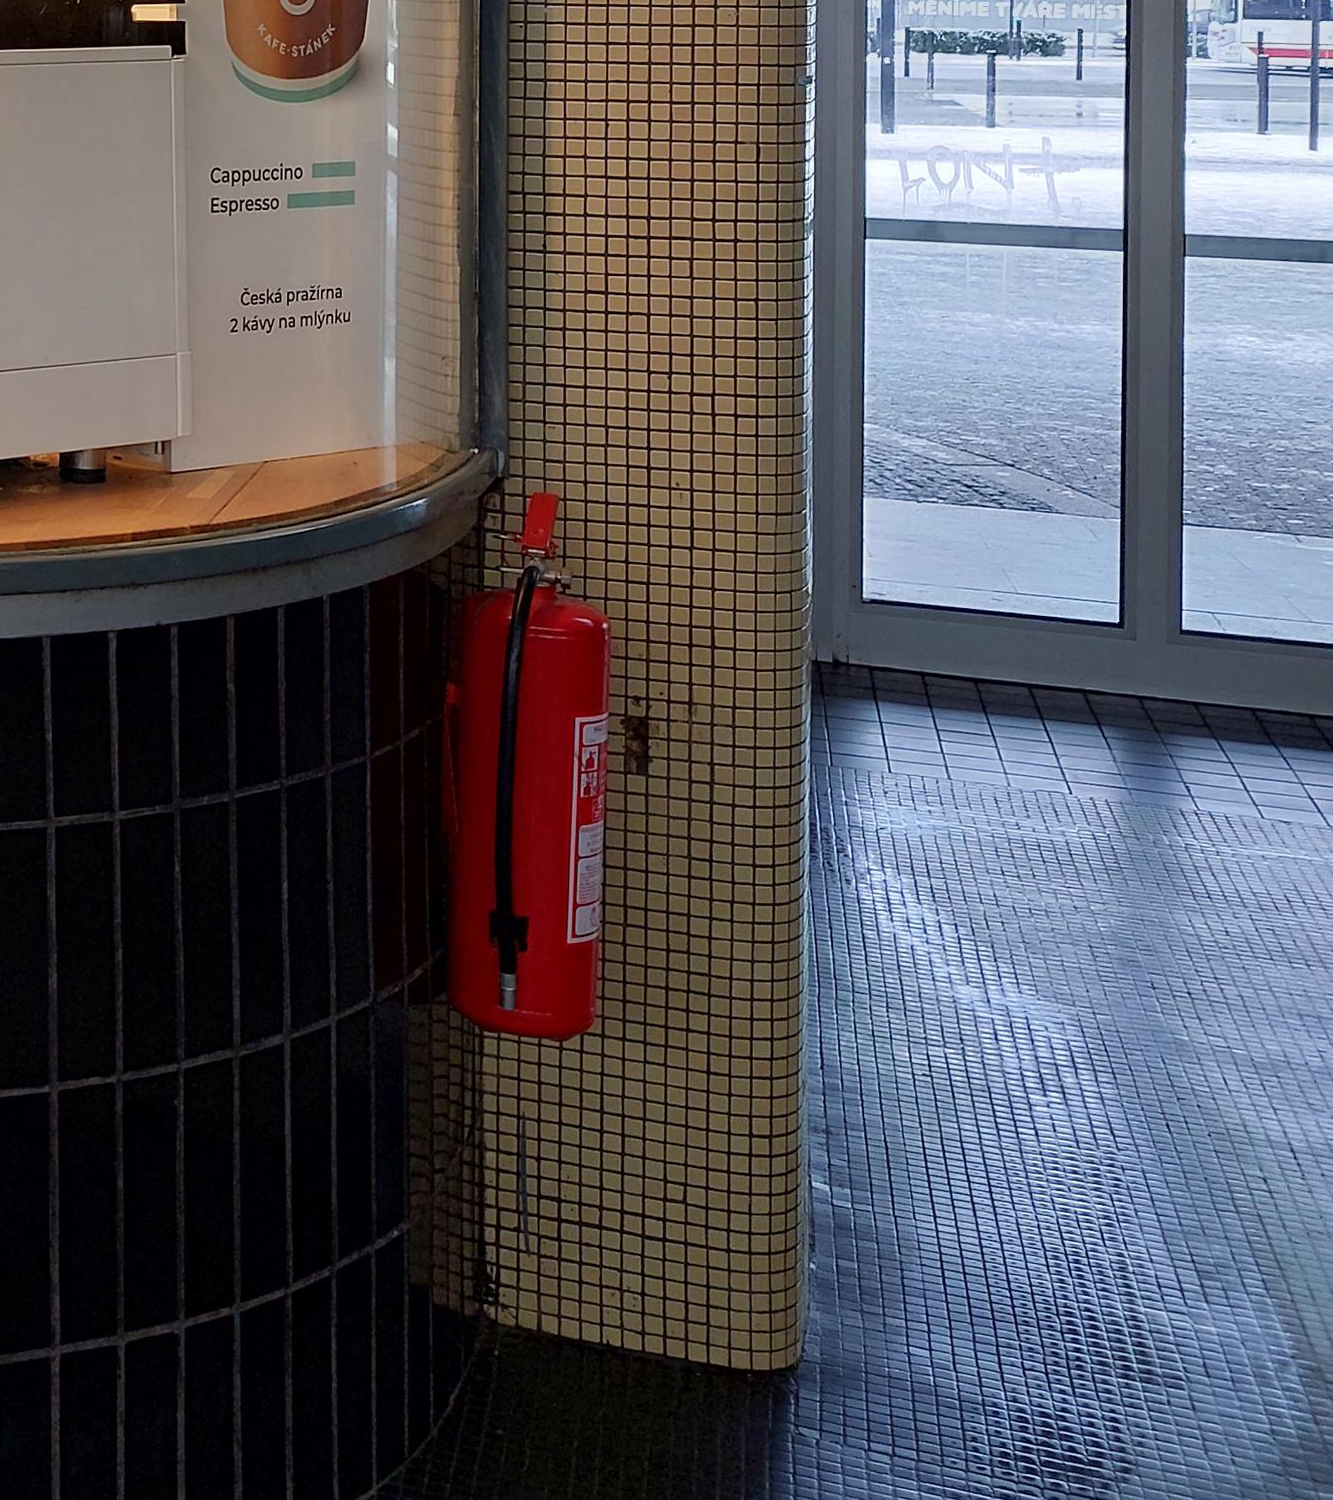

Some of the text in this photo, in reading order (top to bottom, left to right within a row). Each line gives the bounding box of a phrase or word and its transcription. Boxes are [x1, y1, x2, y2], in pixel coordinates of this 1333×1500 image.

[210, 163, 303, 187] Cappuccino
[210, 197, 280, 217] Espresso
[240, 285, 342, 306] Česká pražírna
[230, 309, 351, 334] 2 kávy na mlýnku
